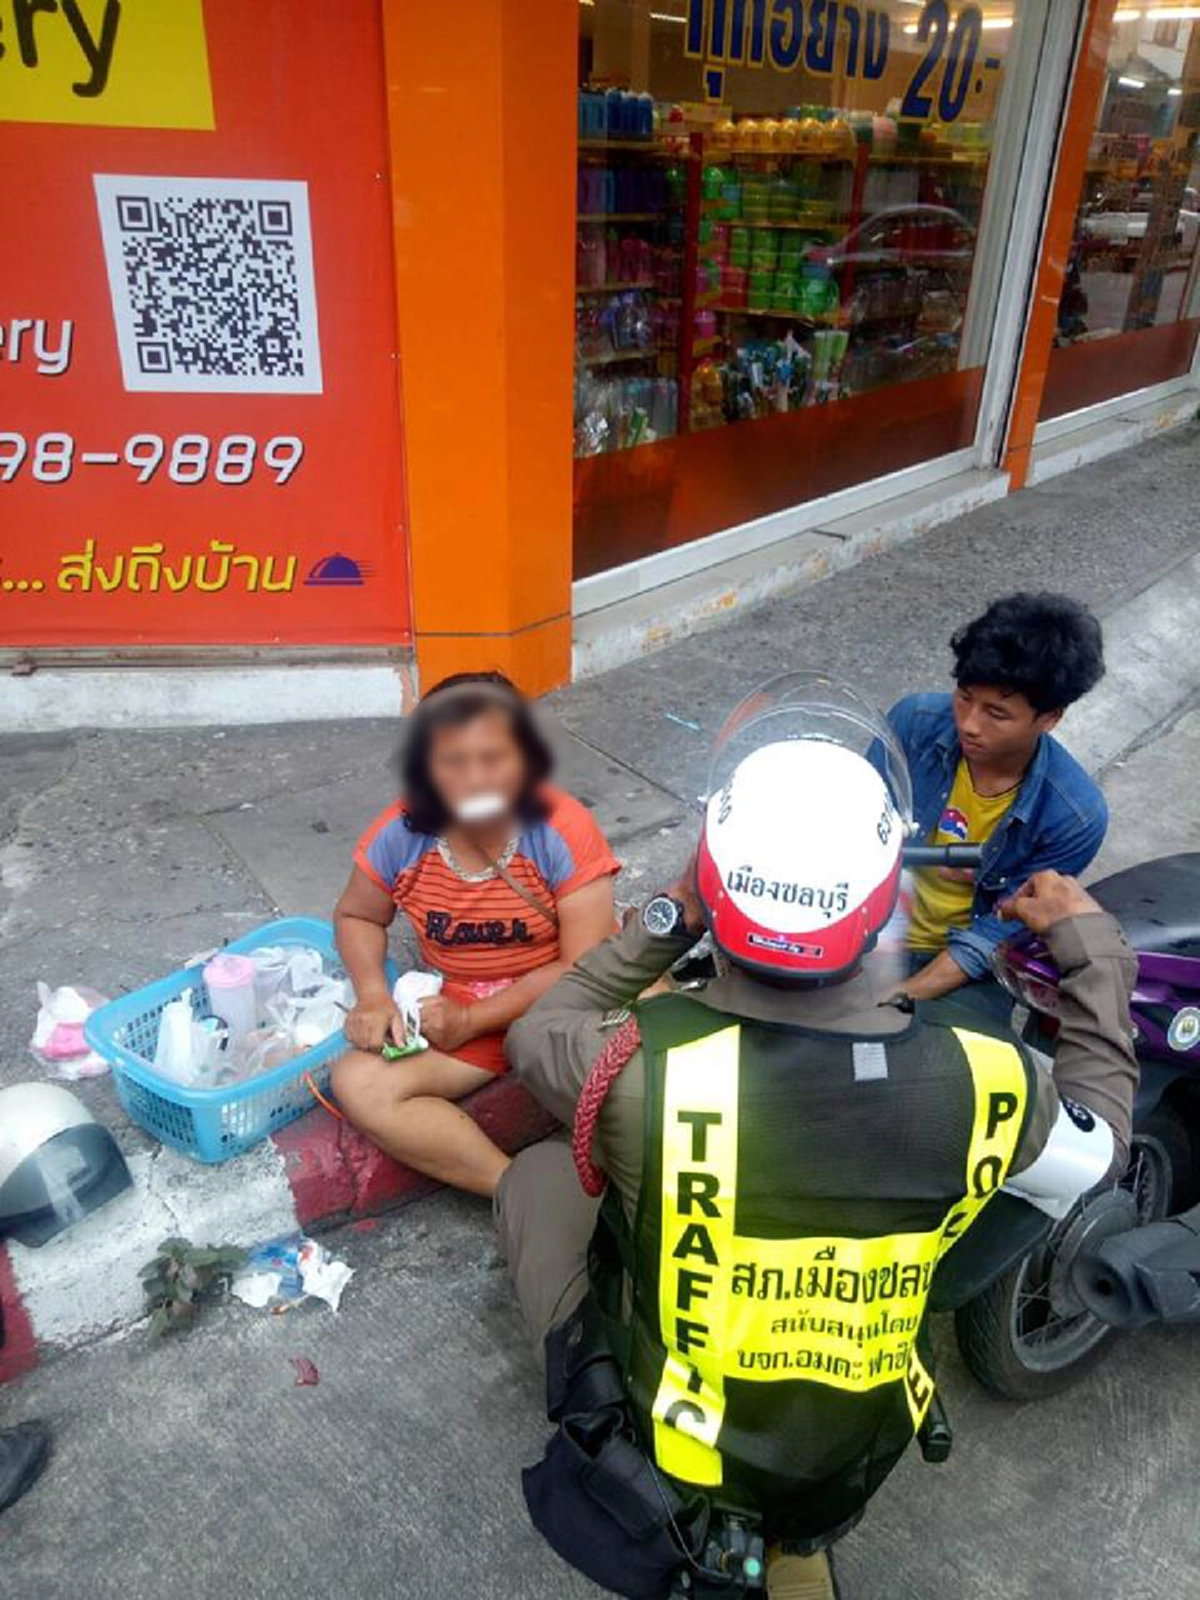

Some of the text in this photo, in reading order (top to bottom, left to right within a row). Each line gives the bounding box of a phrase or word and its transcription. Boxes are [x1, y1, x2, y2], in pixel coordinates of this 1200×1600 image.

[0, 0, 120, 98] ry
[0, 319, 74, 377] ry
[57, 538, 297, 592] ส่งถึงบ้าน
[727, 865, 849, 918] เมืองชลบุรี
